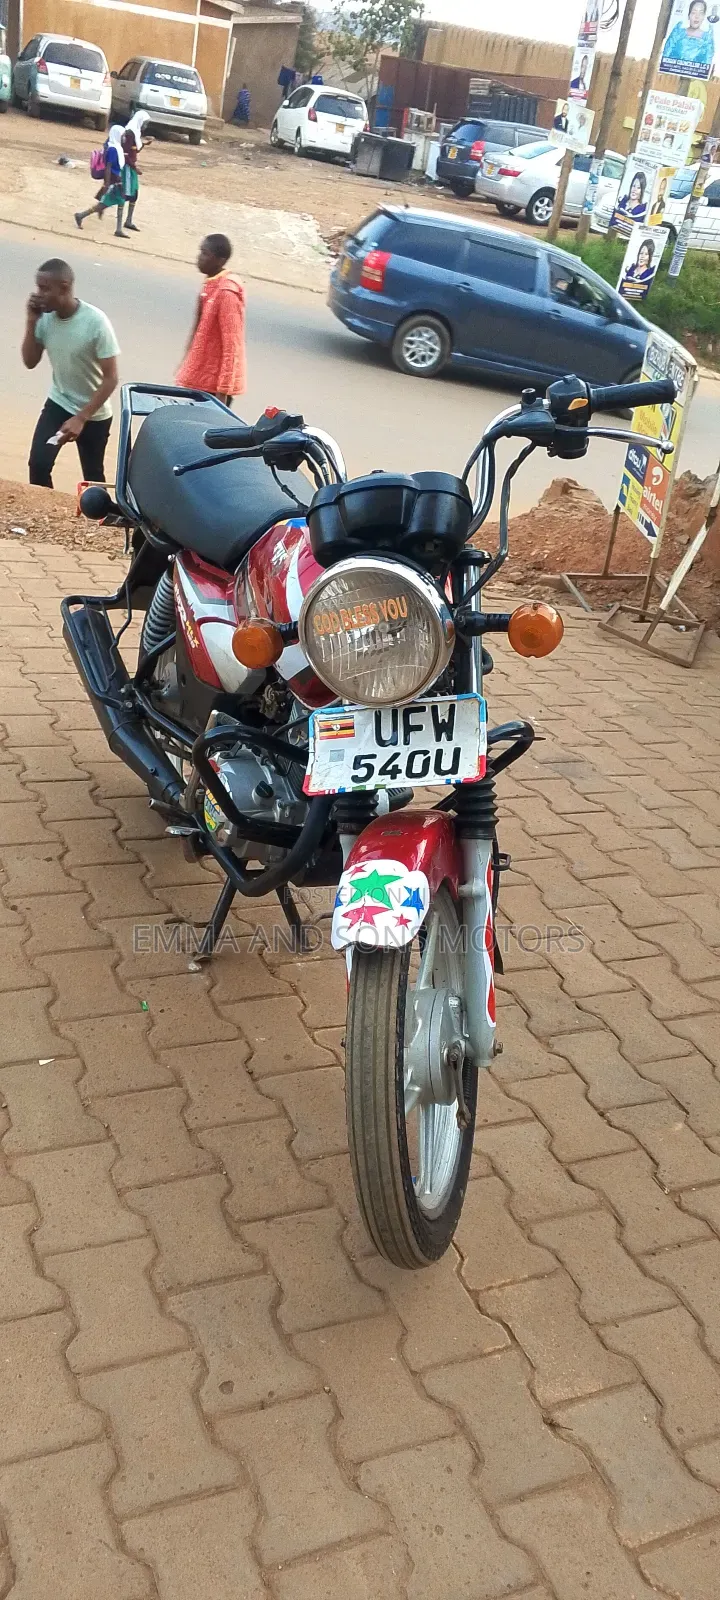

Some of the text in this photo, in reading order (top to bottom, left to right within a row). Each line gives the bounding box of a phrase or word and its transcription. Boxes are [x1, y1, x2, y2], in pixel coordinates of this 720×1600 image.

[643, 485, 663, 515] airtel
[313, 596, 408, 635] GOD BLESS YOU
[374, 703, 456, 748] UFW
[351, 746, 462, 784] 540U
